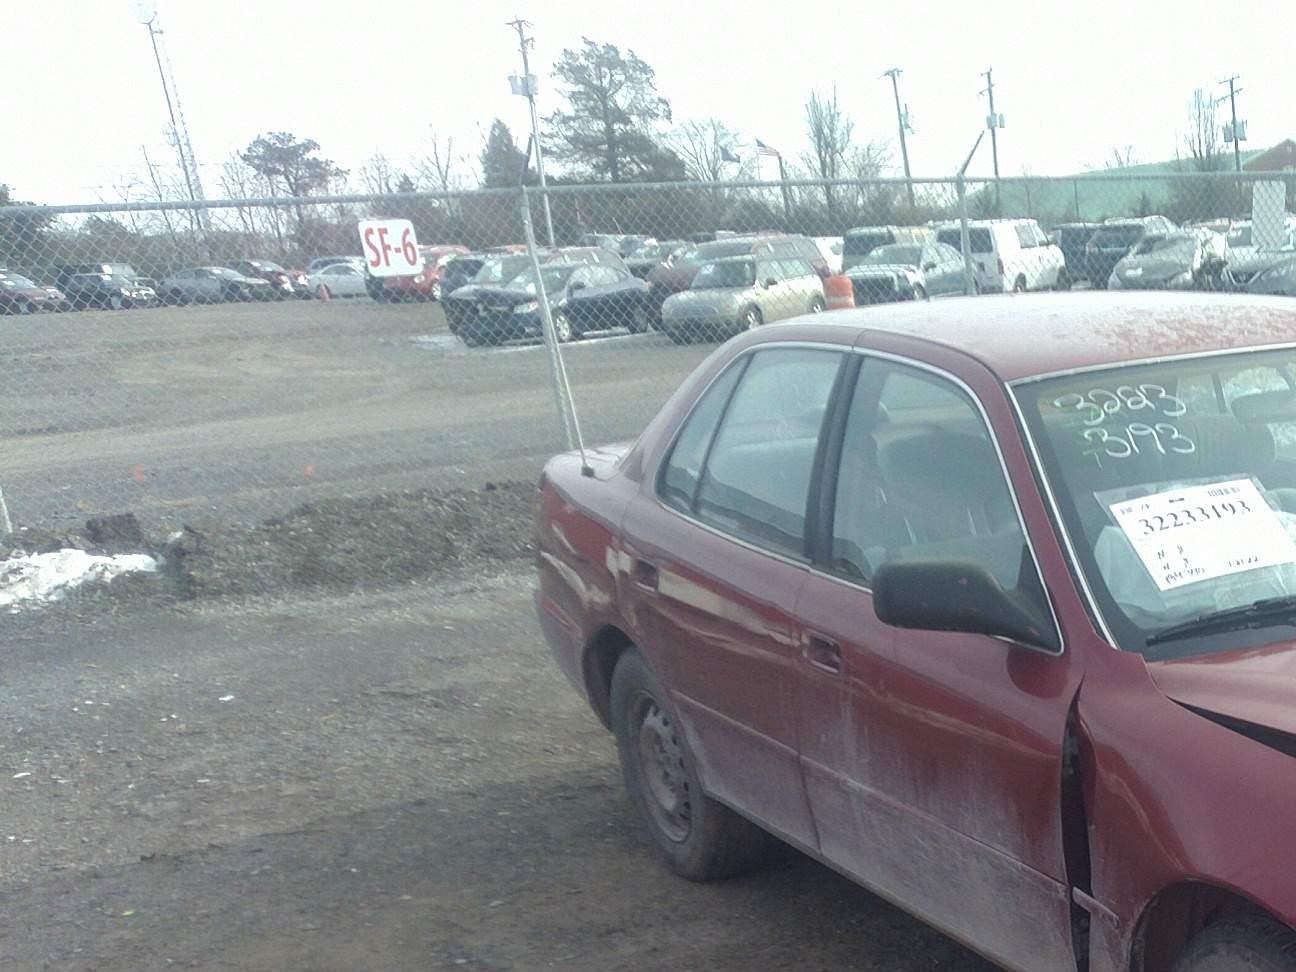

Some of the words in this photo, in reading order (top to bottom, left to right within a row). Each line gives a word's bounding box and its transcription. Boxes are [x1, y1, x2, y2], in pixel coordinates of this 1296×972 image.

[364, 227, 417, 268] SF-6
[1083, 422, 1196, 458] 3193
[1137, 499, 1252, 534] 32233193
